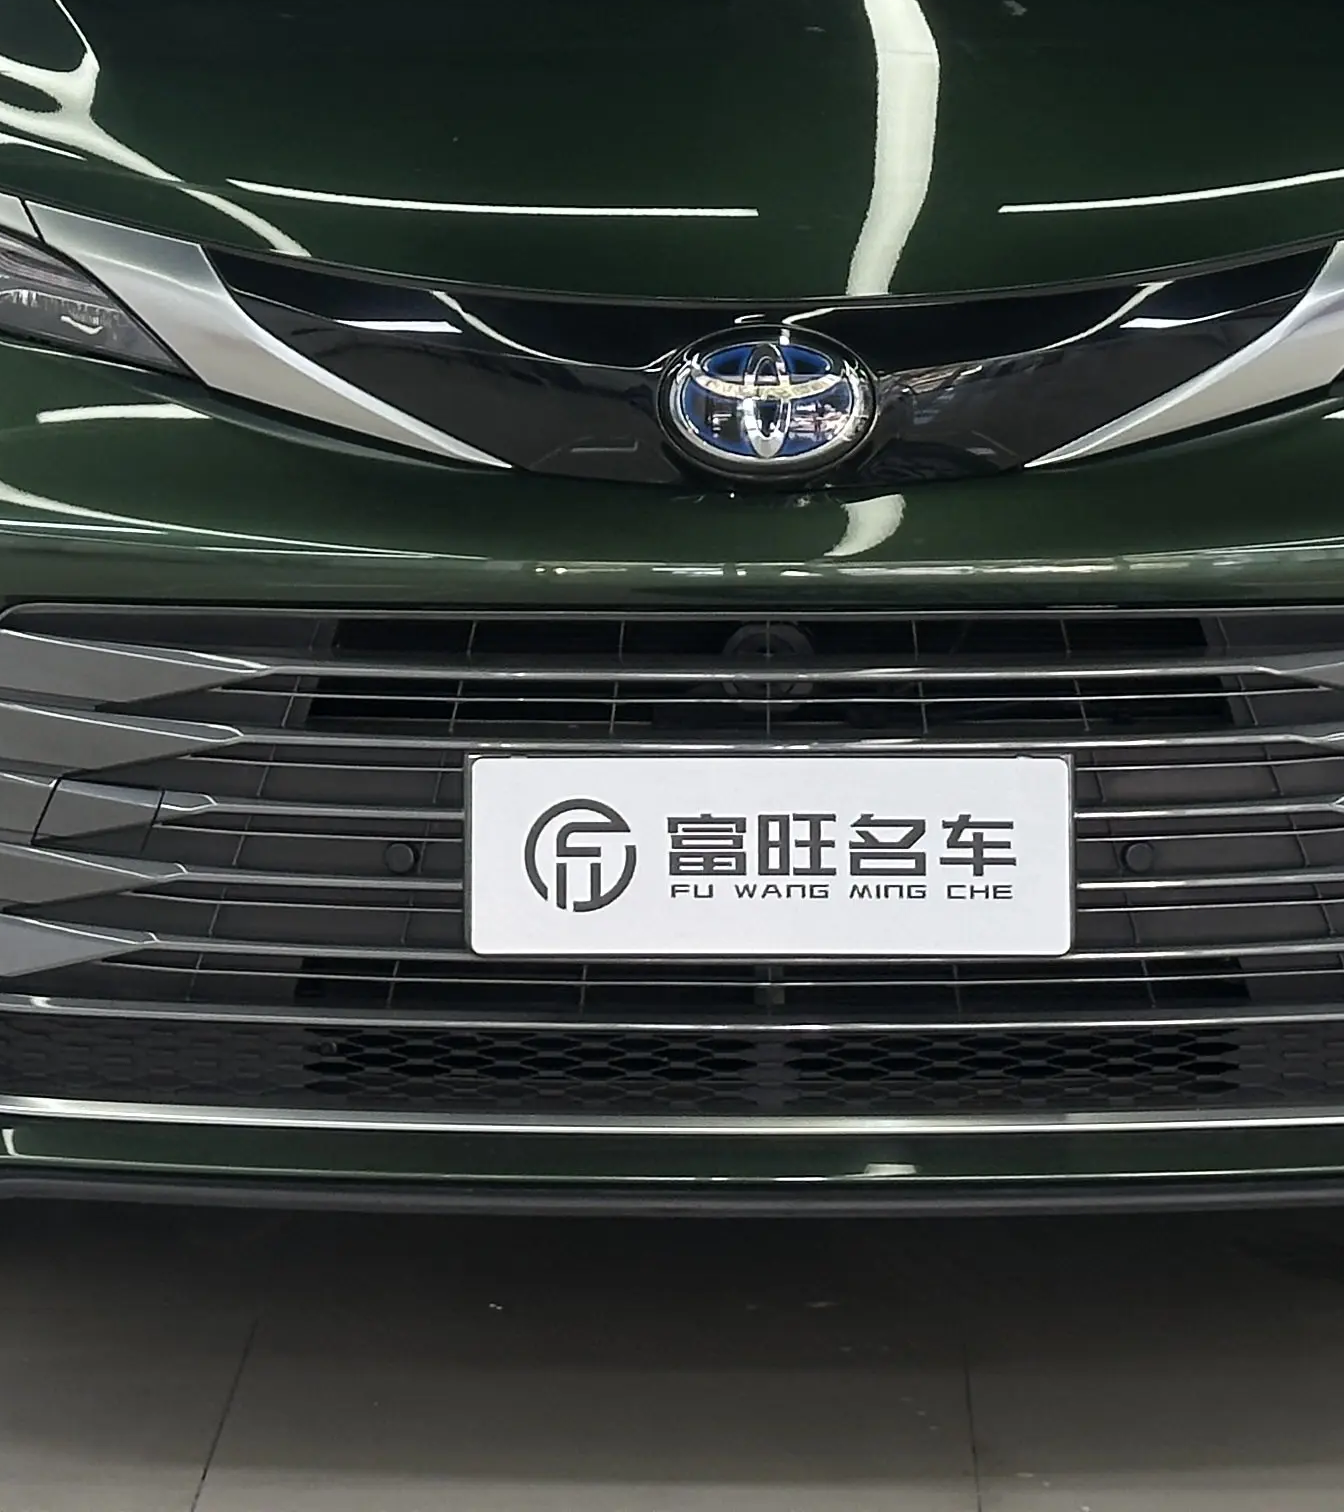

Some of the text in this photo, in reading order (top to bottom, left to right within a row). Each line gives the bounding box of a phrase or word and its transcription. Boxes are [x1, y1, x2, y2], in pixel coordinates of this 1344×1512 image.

[666, 812, 1017, 877] 富旺名车
[670, 883, 1013, 900] FU WANG MING CHE
